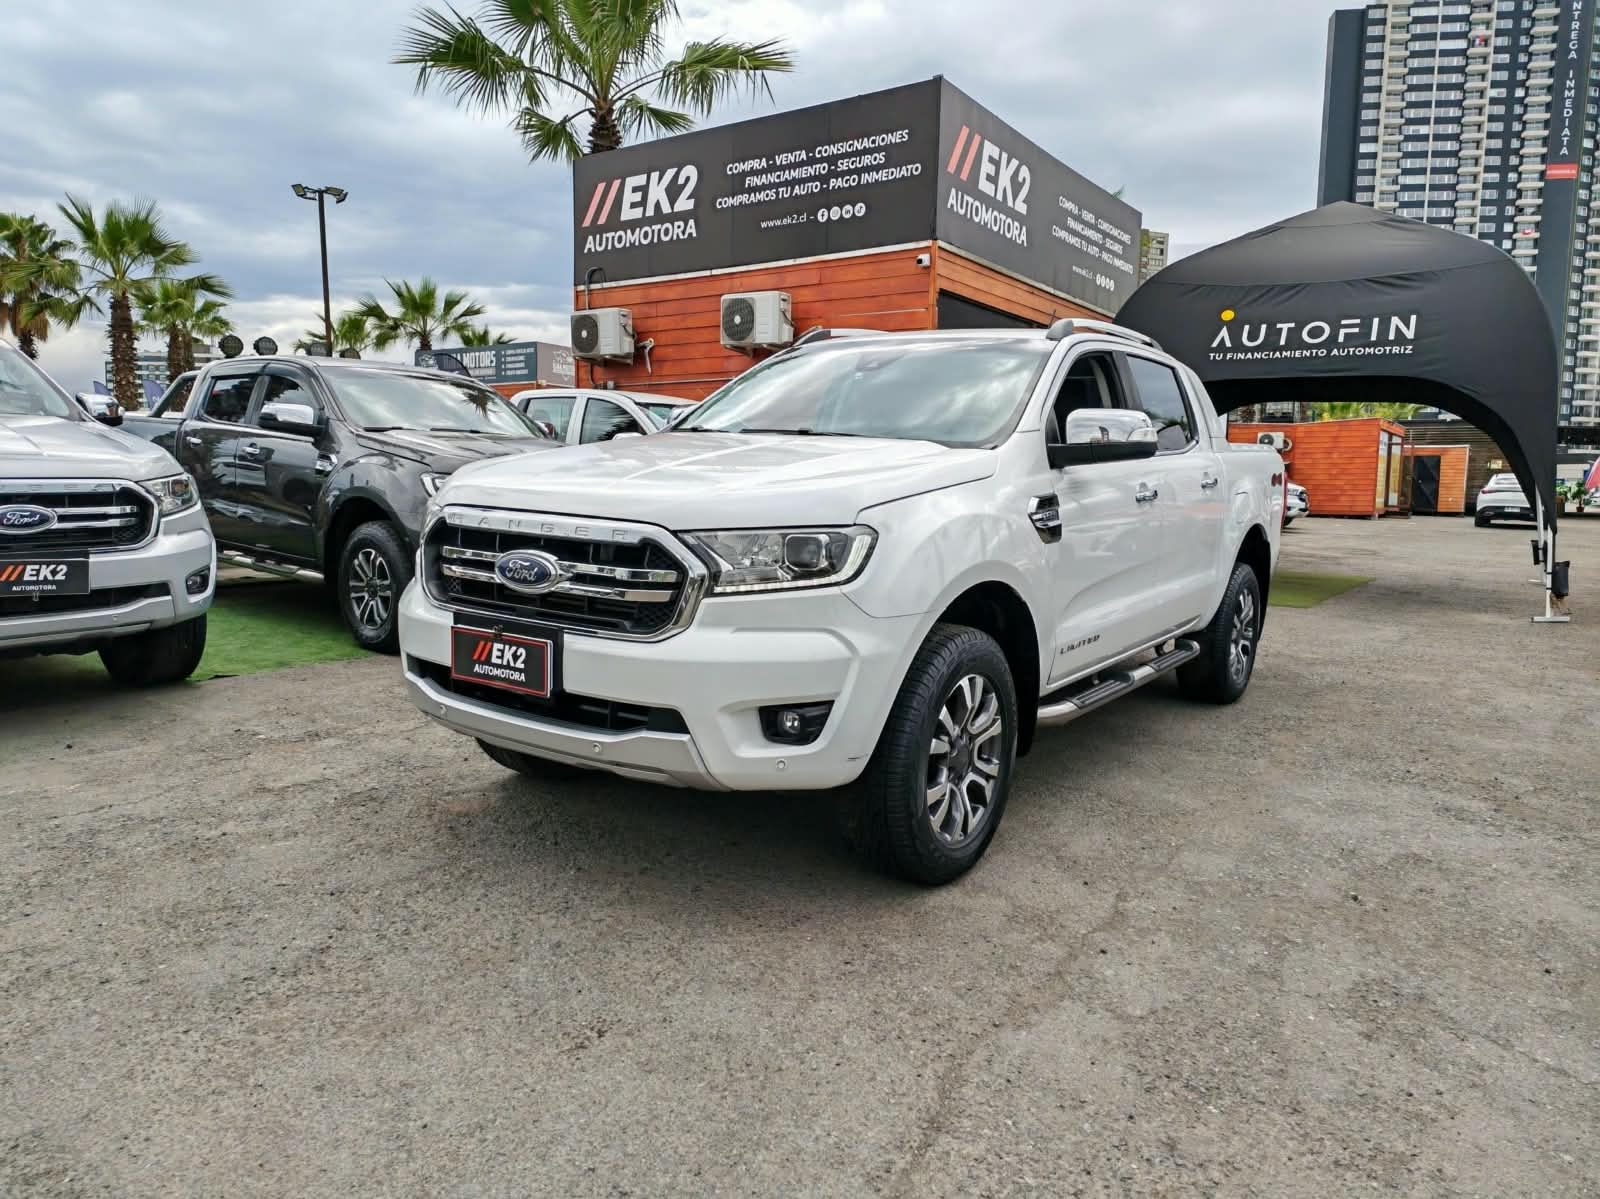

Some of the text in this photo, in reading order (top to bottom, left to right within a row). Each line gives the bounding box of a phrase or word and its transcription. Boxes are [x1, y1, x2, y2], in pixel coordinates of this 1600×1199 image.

[1559, 69, 1575, 155] INMEDIATA
[726, 157, 767, 175] COMPRA
[775, 150, 807, 166] VENTA
[815, 129, 909, 158] CONSIGNACIONES
[716, 189, 776, 209] COMPRAMOS
[778, 187, 791, 199] TU
[793, 181, 821, 197] AUTO
[829, 175, 858, 190] PAGO
[860, 163, 922, 185] INMEDIATO
[745, 163, 829, 188] FINANCIAMIENTO
[836, 152, 886, 172] SEGUROS
[760, 212, 807, 229] www.ek2.cl
[947, 187, 1027, 247] AUTOMOTORA
[584, 218, 697, 253] AUTOMOTORA
[1210, 310, 1417, 347] AUTOFIN
[462, 350, 496, 368] MOTORS
[1208, 345, 1413, 361] TU FINANCIAMIENTO AUTOMOTRIZ
[3, 511, 41, 526] Ford
[504, 558, 538, 582] Ford
[473, 663, 526, 683] AUTOMOTORA
